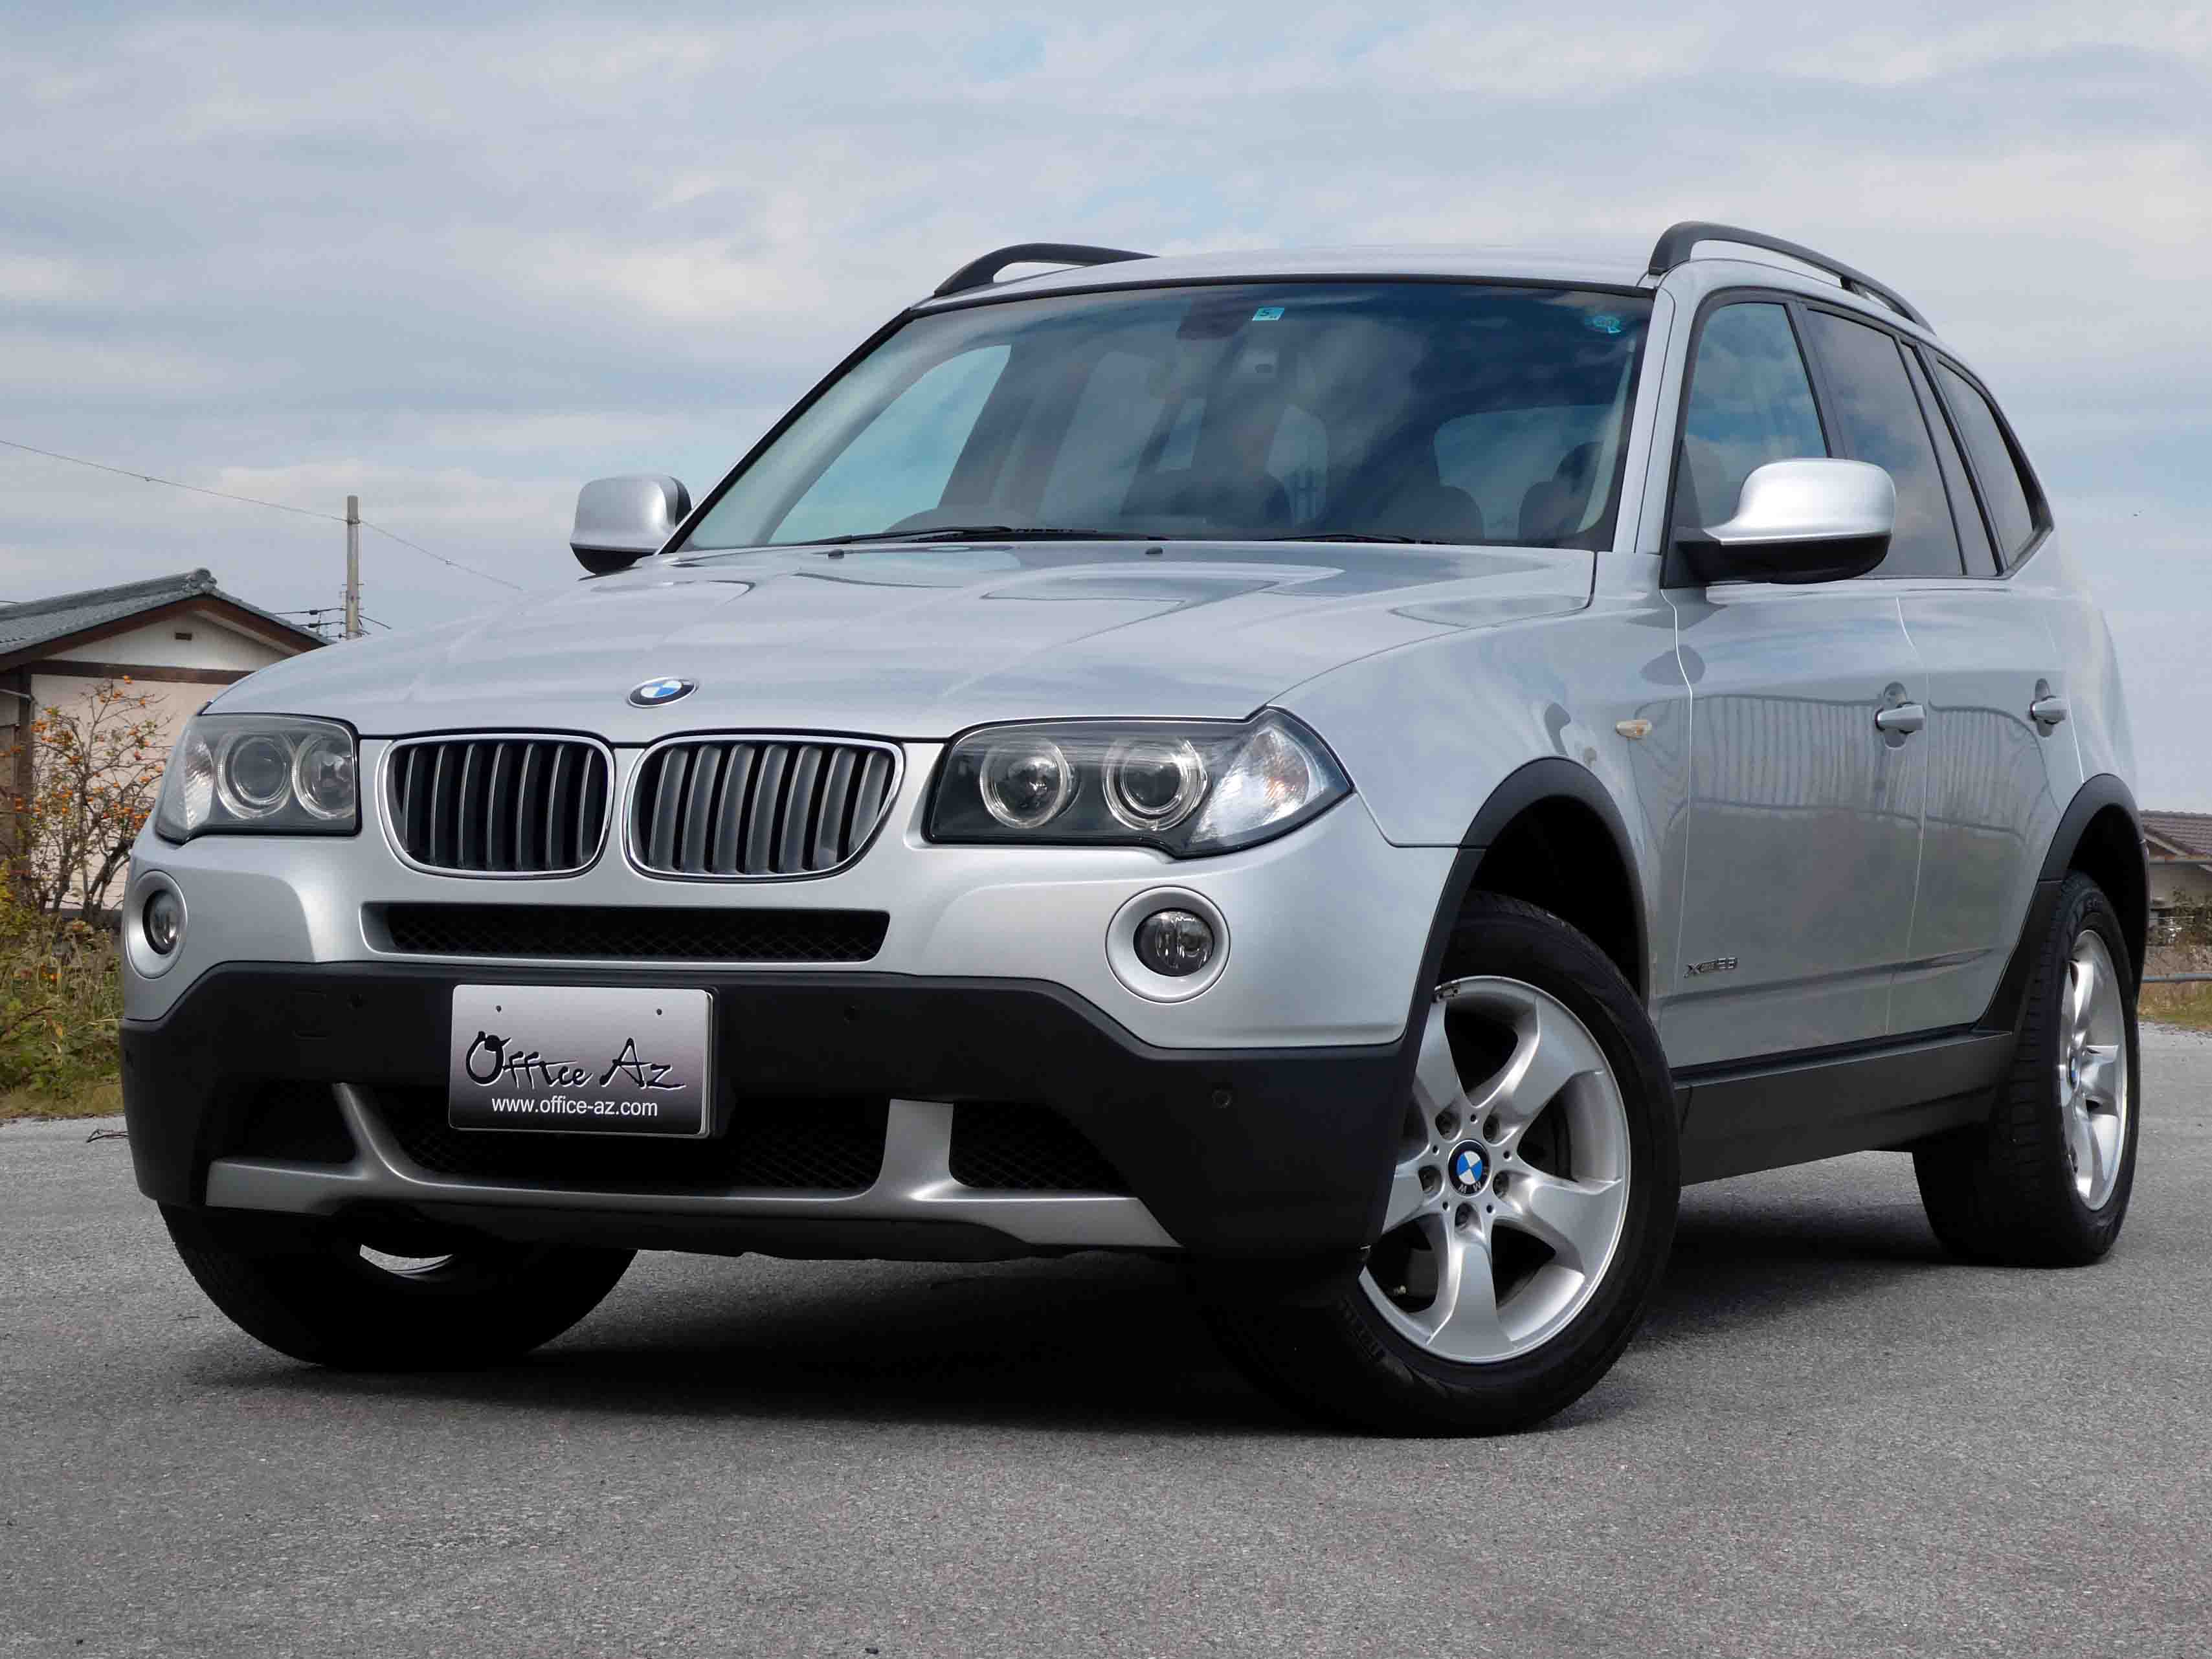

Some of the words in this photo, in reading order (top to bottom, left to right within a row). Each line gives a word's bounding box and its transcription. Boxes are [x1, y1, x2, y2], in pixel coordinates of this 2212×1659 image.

[466, 1031, 593, 1089] Office
[599, 1038, 686, 1090] Az
[491, 1095, 658, 1117] www.office-az.com
